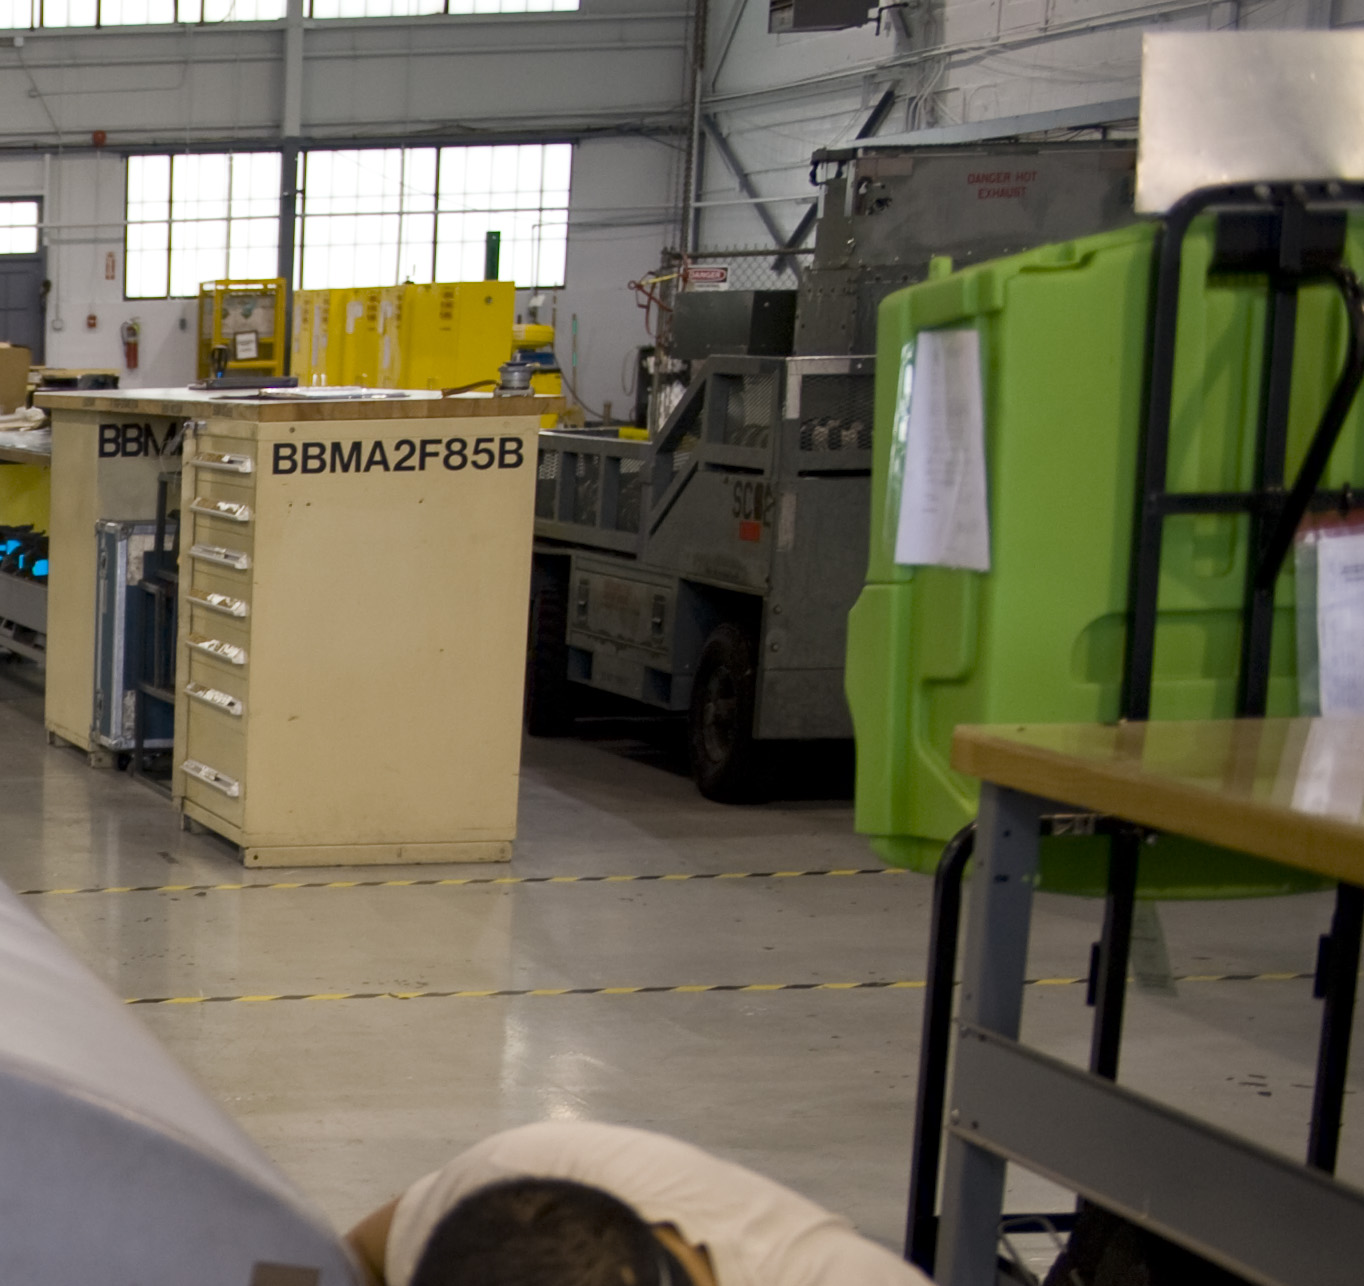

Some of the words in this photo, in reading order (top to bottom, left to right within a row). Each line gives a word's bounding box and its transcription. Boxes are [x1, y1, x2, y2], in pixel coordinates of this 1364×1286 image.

[967, 171, 1011, 184] DANGER
[1016, 170, 1037, 182] HOT
[978, 186, 1027, 199] EXHAUST
[272, 437, 524, 474] BBMA2F85B
